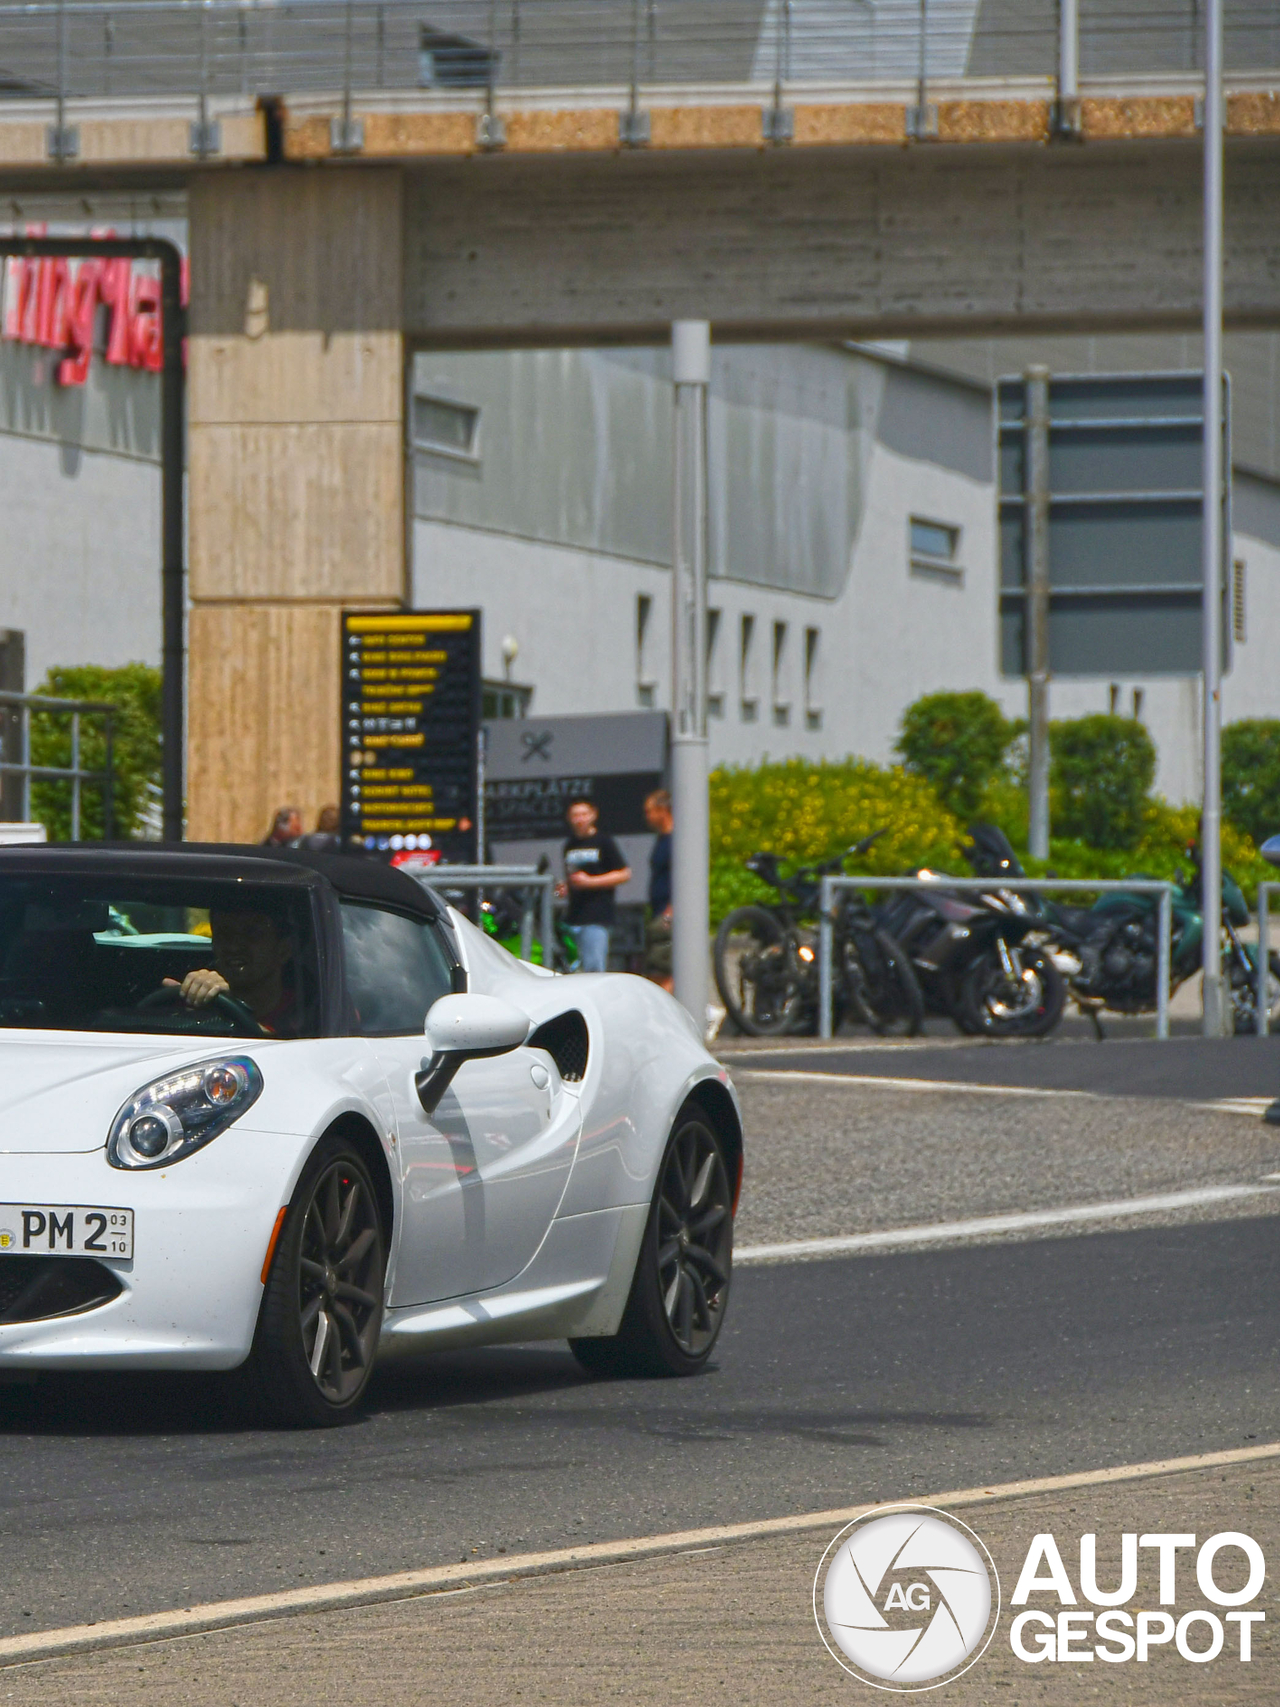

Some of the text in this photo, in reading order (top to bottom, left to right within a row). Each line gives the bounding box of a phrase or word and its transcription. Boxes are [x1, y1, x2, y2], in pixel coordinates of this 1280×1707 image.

[111, 1214, 127, 1226] 03
[22, 1211, 73, 1249] PM
[84, 1213, 108, 1251] 2
[111, 1240, 126, 1253] 10
